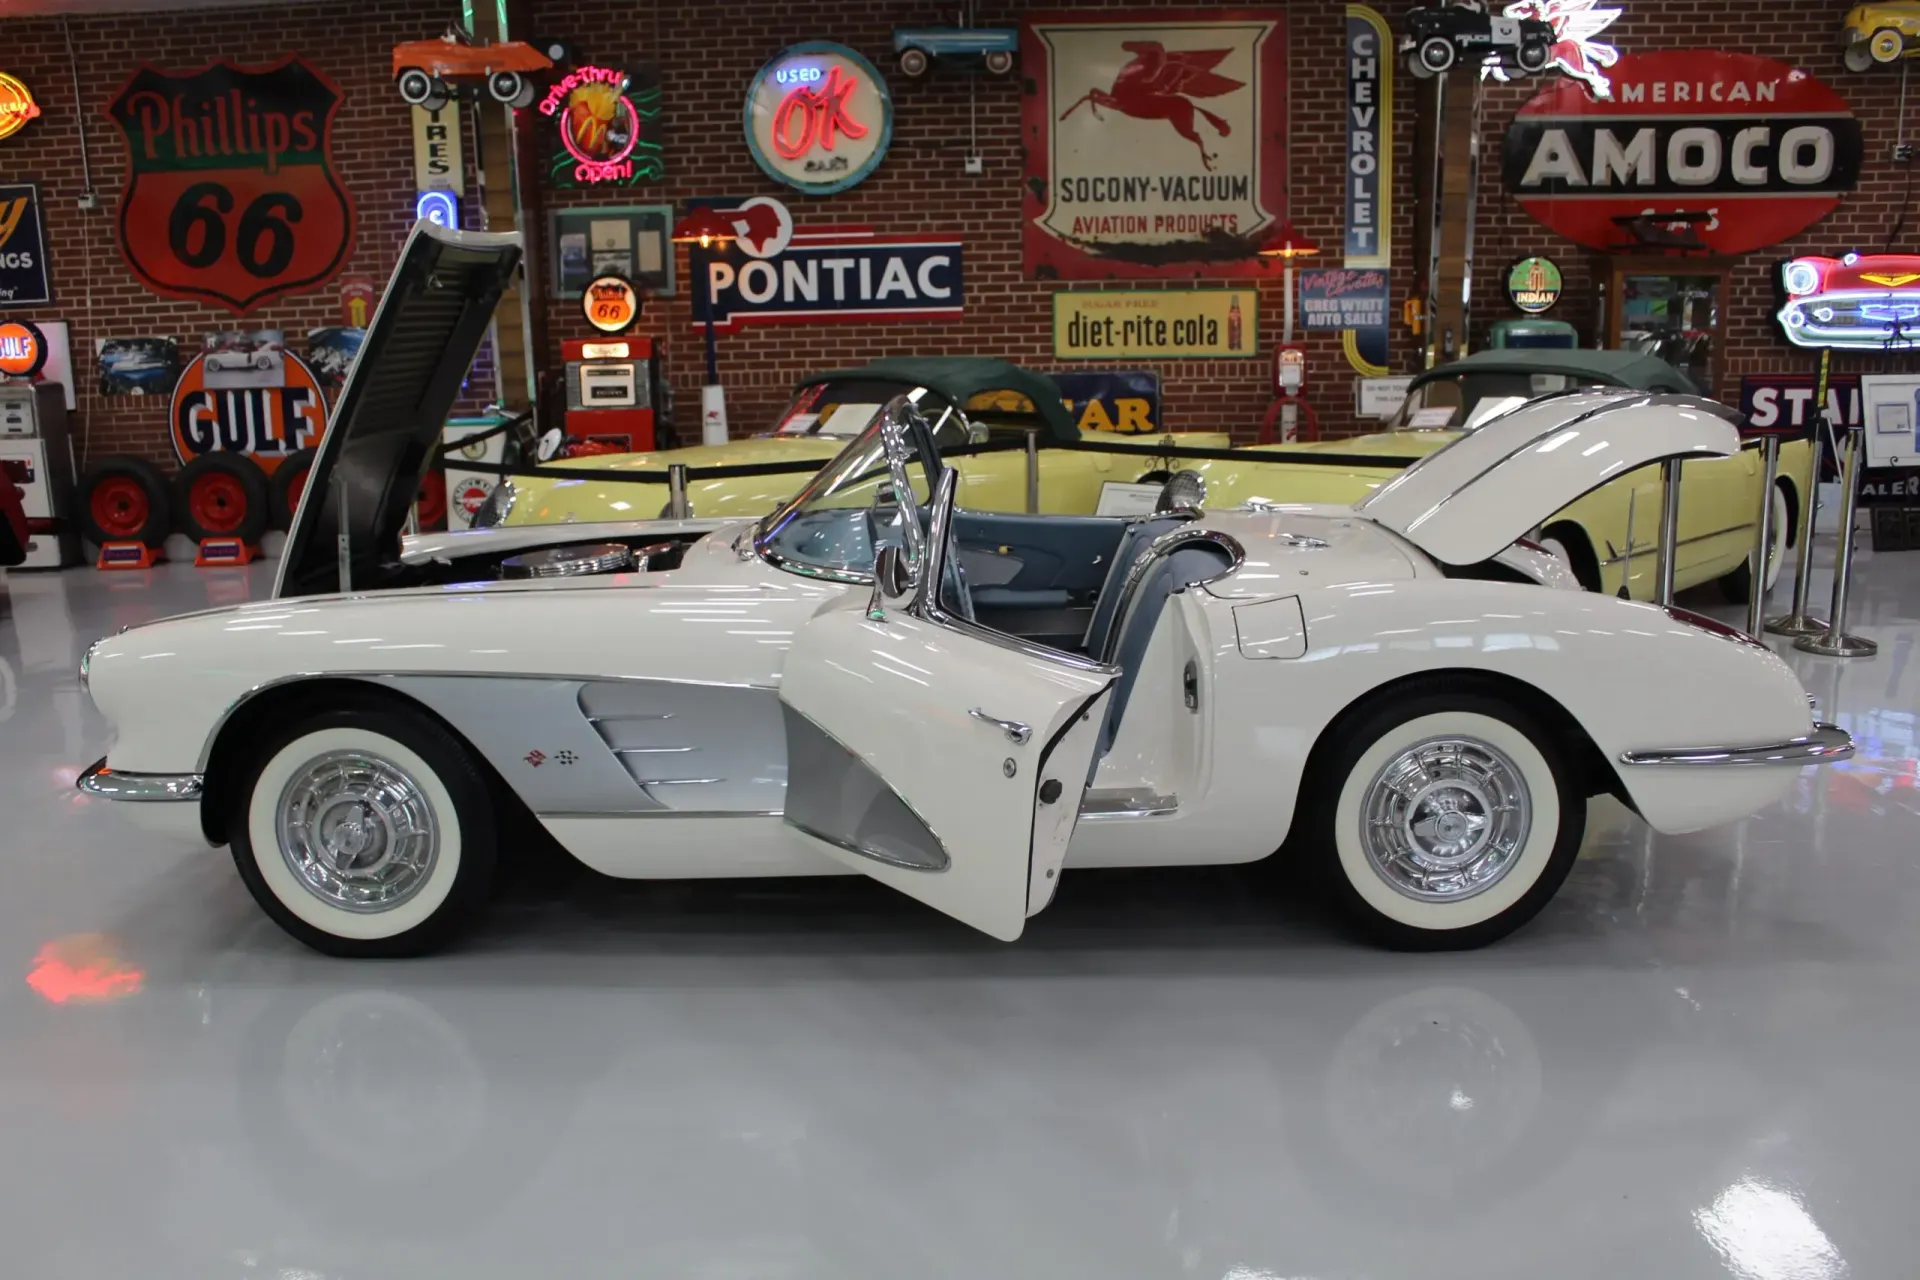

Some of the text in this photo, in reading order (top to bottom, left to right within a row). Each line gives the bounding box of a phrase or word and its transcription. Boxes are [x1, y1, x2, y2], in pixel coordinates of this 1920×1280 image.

[538, 65, 625, 116] Drive-Thru
[776, 67, 821, 83] USED
[126, 88, 317, 173] Phillips
[772, 64, 869, 160] OK
[426, 108, 450, 175] IRES
[1350, 34, 1376, 248] CHEVROLET
[1520, 126, 1835, 186] AMOCO
[575, 159, 633, 184] Open!
[1061, 176, 1248, 203] SOCONY-VACUUM
[168, 181, 304, 278] 66
[1072, 214, 1239, 234] AVIATION PRODUCTS
[708, 255, 952, 305] PONTIAC
[1516, 290, 1554, 303] INDIAN
[597, 304, 621, 320] 66
[1304, 299, 1339, 312] GREG
[1307, 312, 1383, 326] AUTO SALES
[1068, 311, 1218, 347] diet-rite cola
[179, 387, 316, 456] GULF
